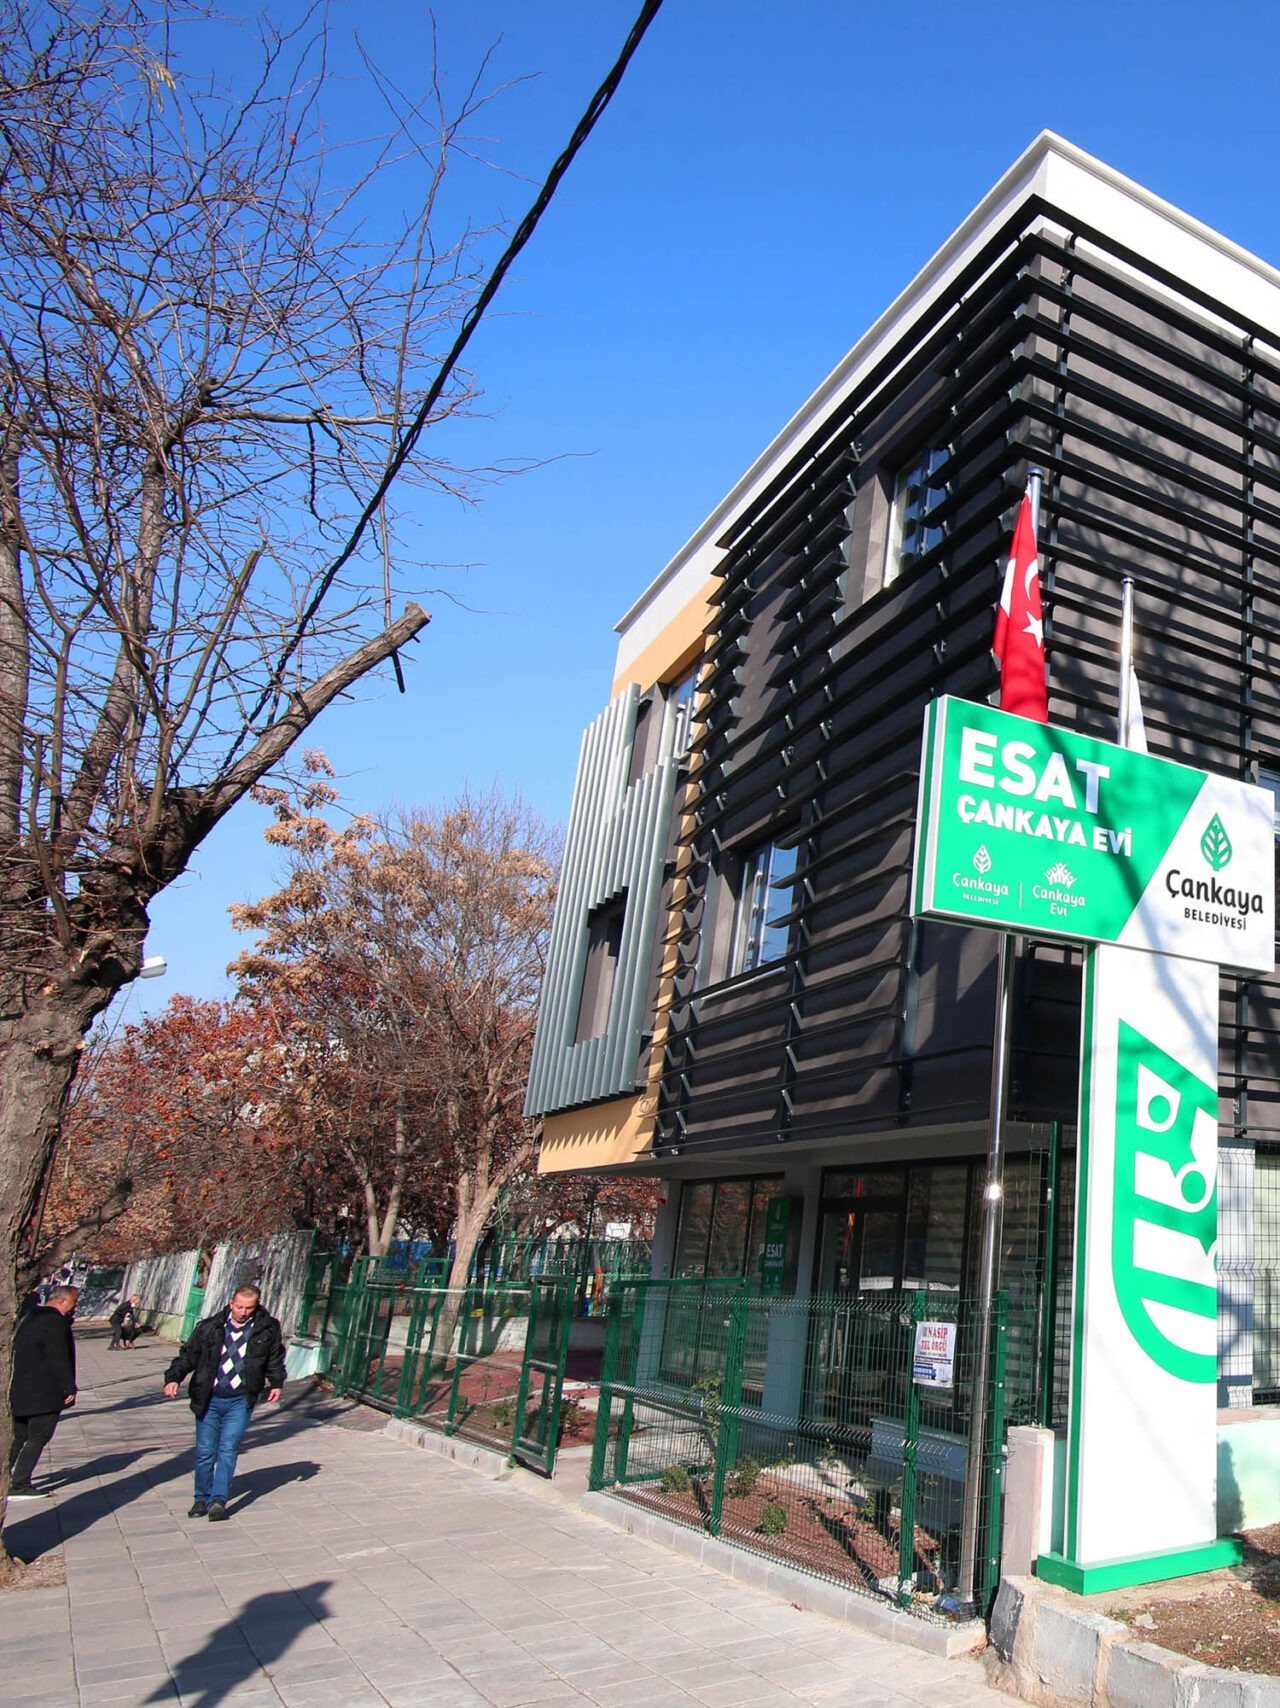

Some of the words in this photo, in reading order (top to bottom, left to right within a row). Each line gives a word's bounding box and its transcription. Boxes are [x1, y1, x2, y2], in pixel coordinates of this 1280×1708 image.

[959, 727, 1110, 814] ESAT
[957, 795, 1087, 848] ÇANKAYA
[1092, 826, 1133, 857] EVİ
[952, 872, 1010, 896] Çankaya
[1032, 884, 1087, 908] Çankaya
[1165, 869, 1264, 915] Çankaya
[1049, 902, 1068, 917] Evi
[1184, 907, 1247, 931] BELEDİYESİ
[766, 1243, 784, 1258] ESAT
